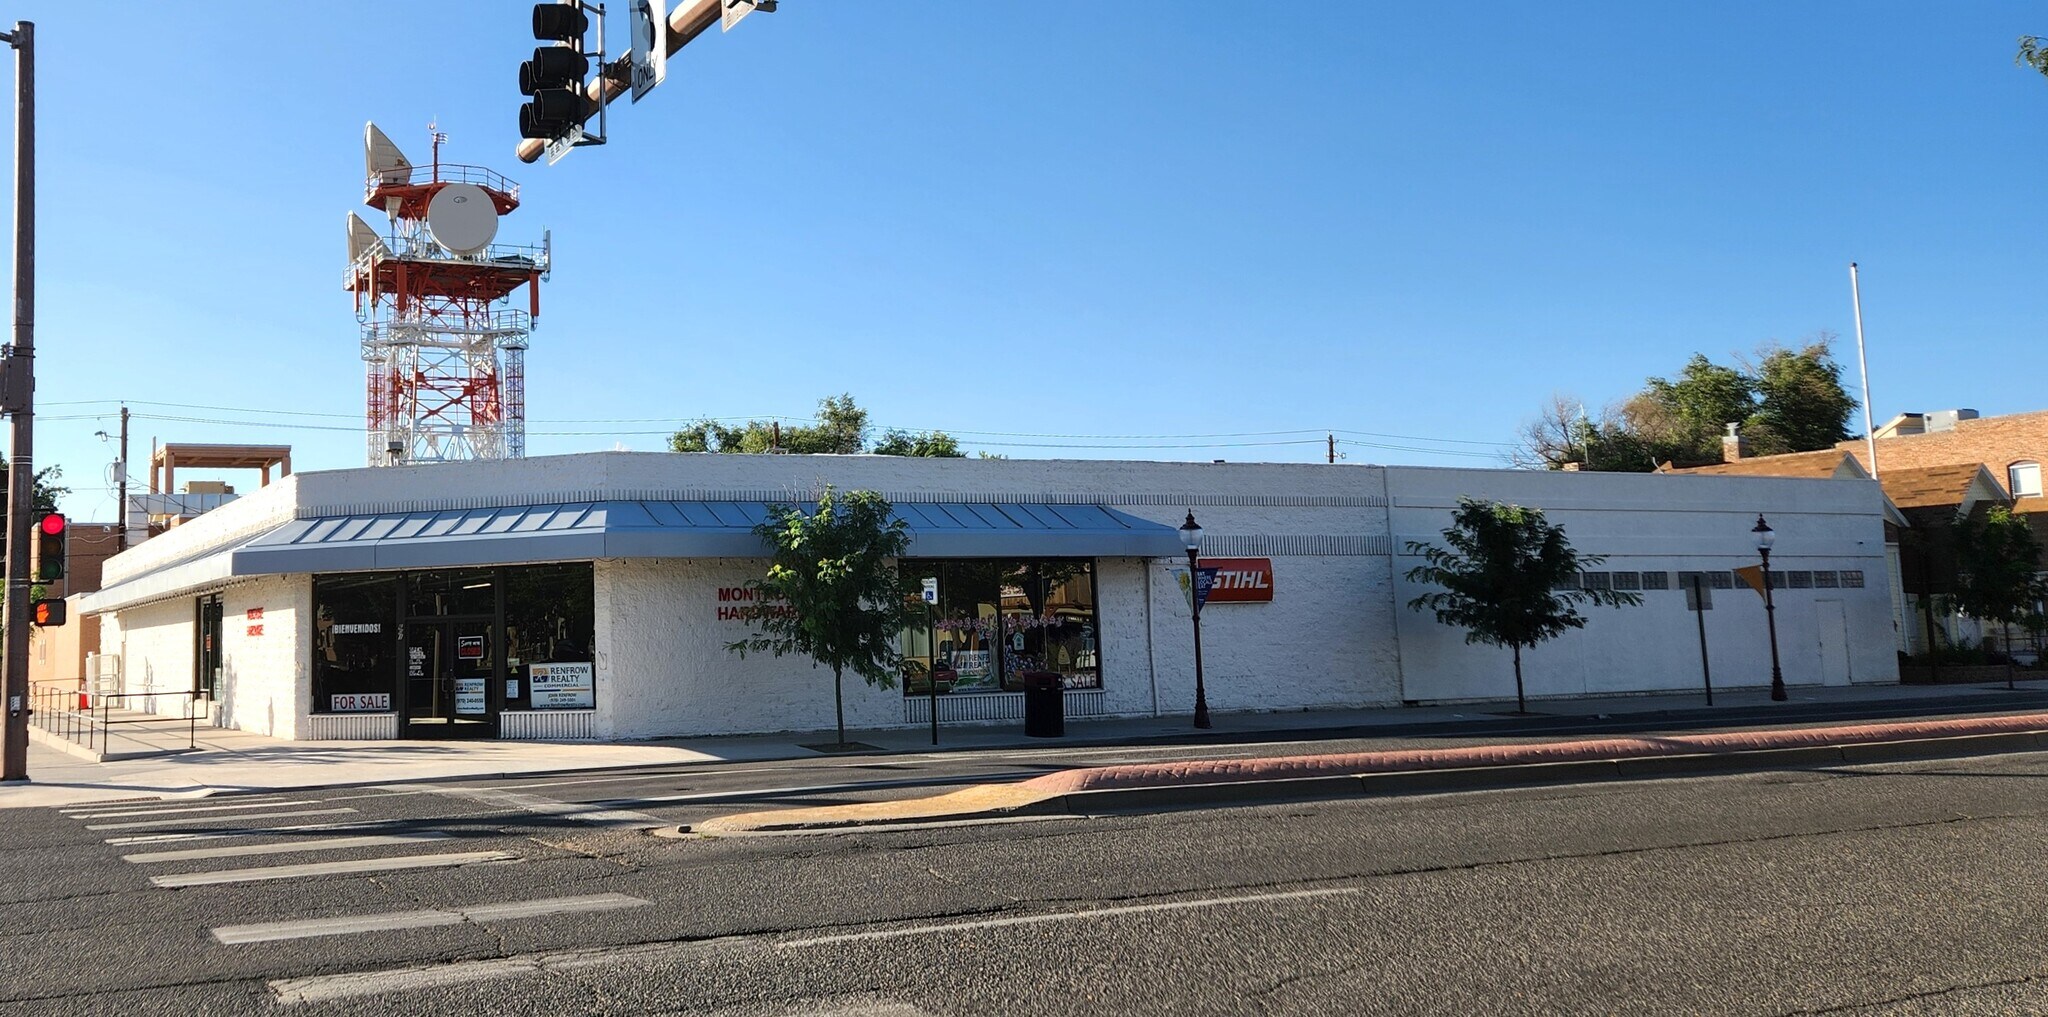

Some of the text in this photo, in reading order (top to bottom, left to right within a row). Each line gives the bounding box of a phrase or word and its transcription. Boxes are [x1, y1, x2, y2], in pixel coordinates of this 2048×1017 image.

[637, 54, 659, 89] ONLY
[1211, 571, 1269, 589] STIHL
[717, 606, 801, 621] HARDWAR
[331, 623, 381, 634] ¡BIENVENIDOS!
[550, 667, 589, 675] RENFROW
[550, 675, 580, 683] REALTY
[1070, 673, 1095, 688] SALE
[333, 695, 388, 709] FOR SALE
